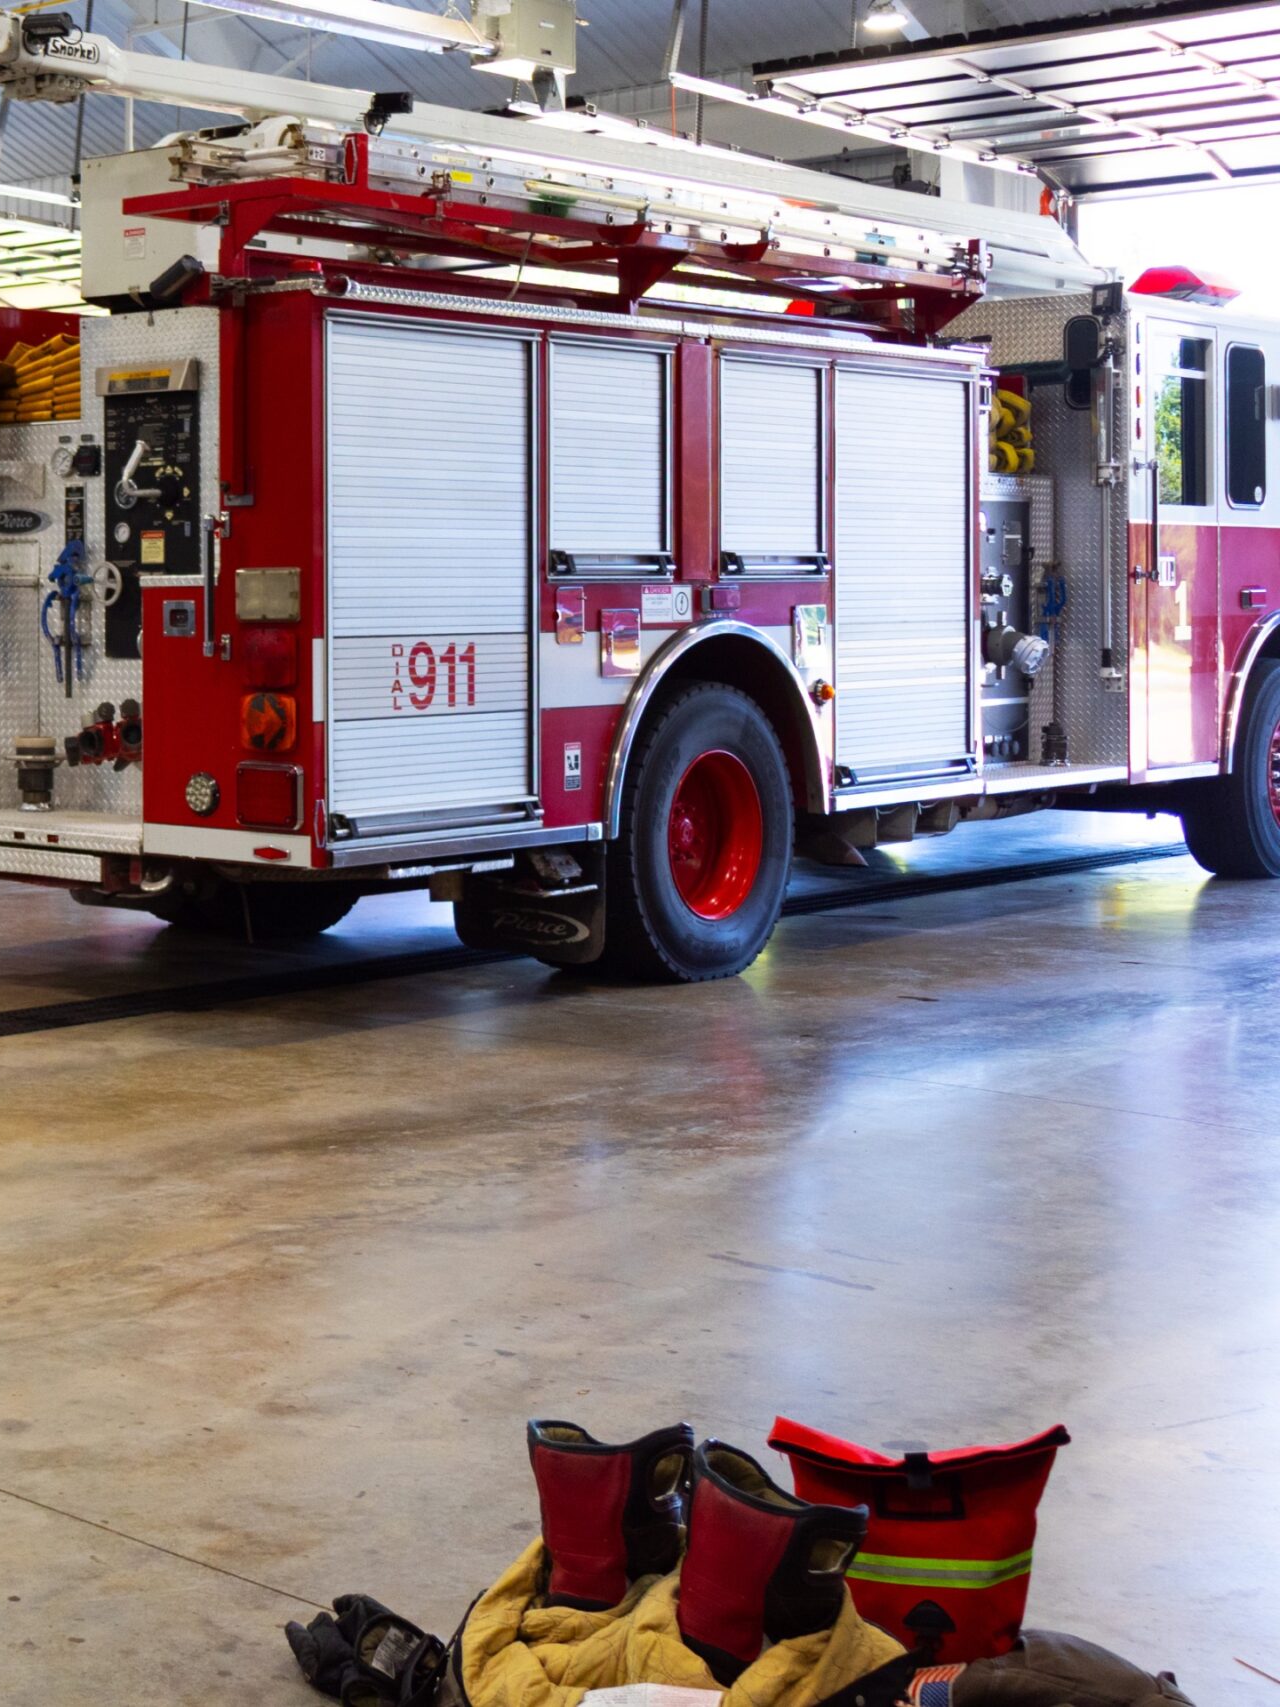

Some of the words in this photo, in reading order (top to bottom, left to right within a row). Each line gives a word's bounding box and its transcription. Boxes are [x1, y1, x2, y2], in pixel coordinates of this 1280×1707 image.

[49, 39, 96, 60] Snorkel
[1173, 580, 1193, 642] 1
[391, 643, 404, 711] DIAL
[407, 641, 476, 711] 911
[492, 911, 568, 936] Pierce
